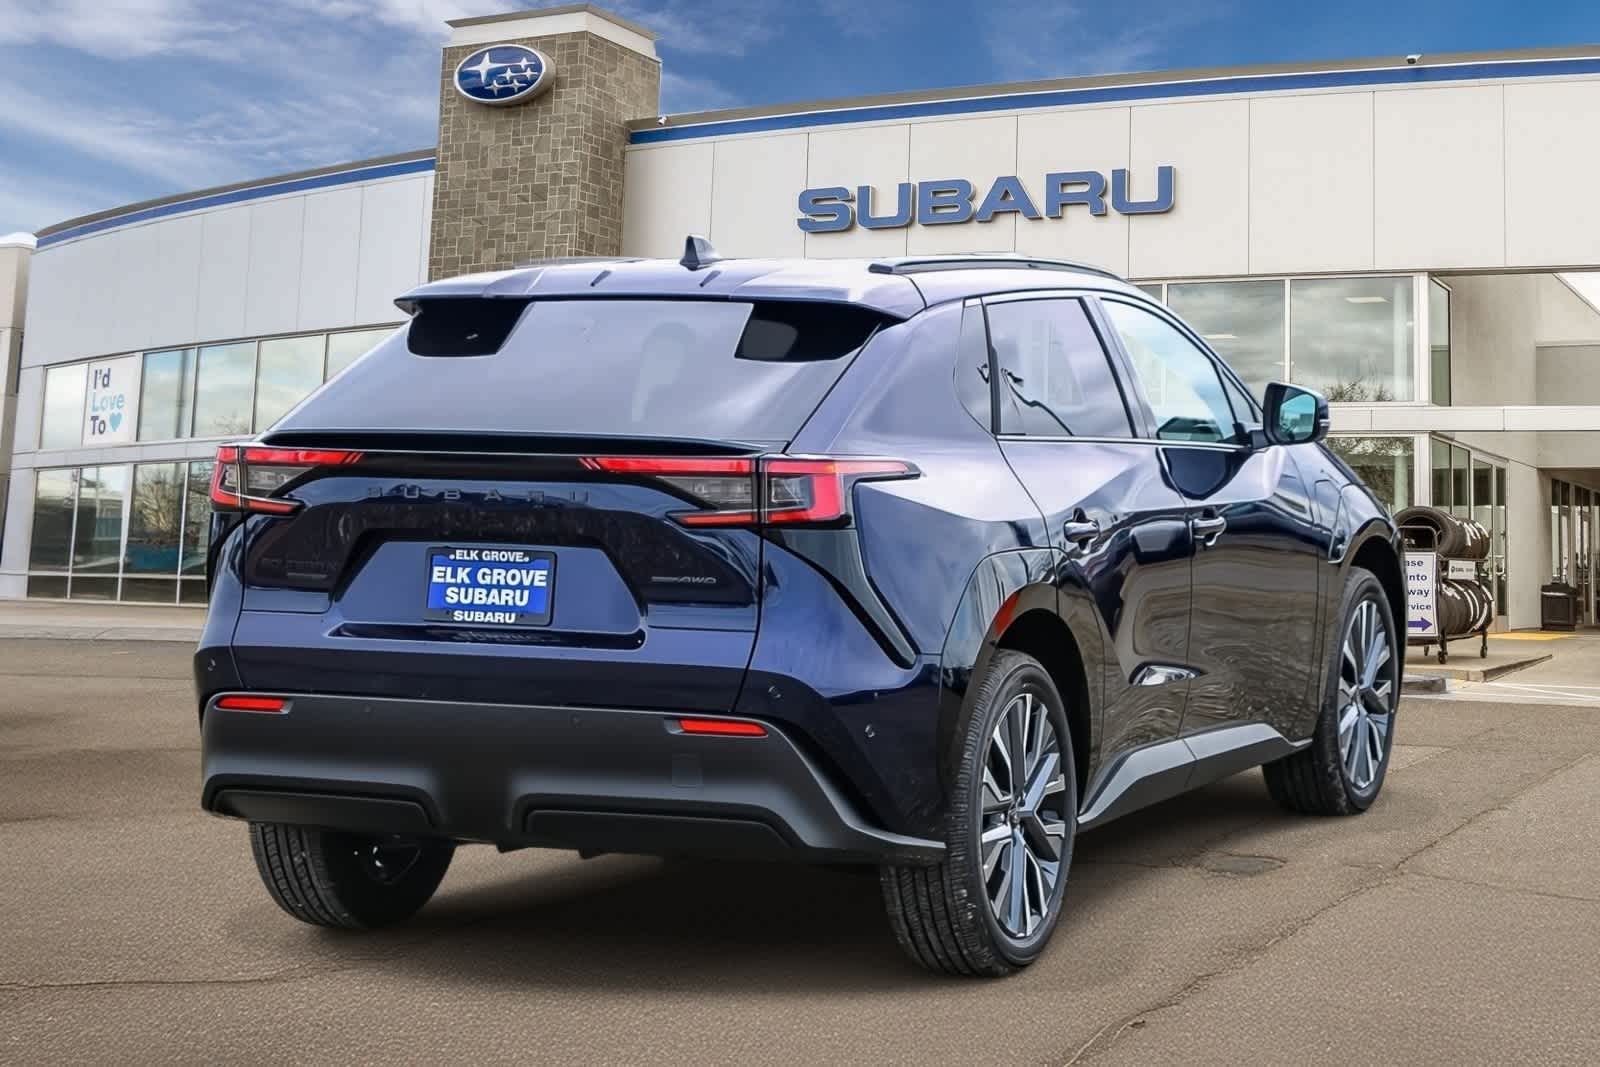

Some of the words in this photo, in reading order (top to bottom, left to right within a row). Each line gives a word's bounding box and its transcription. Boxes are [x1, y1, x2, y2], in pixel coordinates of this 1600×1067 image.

[797, 165, 1177, 233] SUBARU
[94, 367, 111, 389] I'd
[92, 392, 125, 412] Love
[90, 415, 106, 435] To
[455, 550, 479, 560] ELK
[482, 550, 524, 562] GROVE
[432, 566, 472, 584] ELK
[477, 567, 548, 586] GROVE
[1408, 573, 1427, 581] nto
[445, 587, 529, 606] SUBARU
[453, 610, 516, 623] SUBARU
